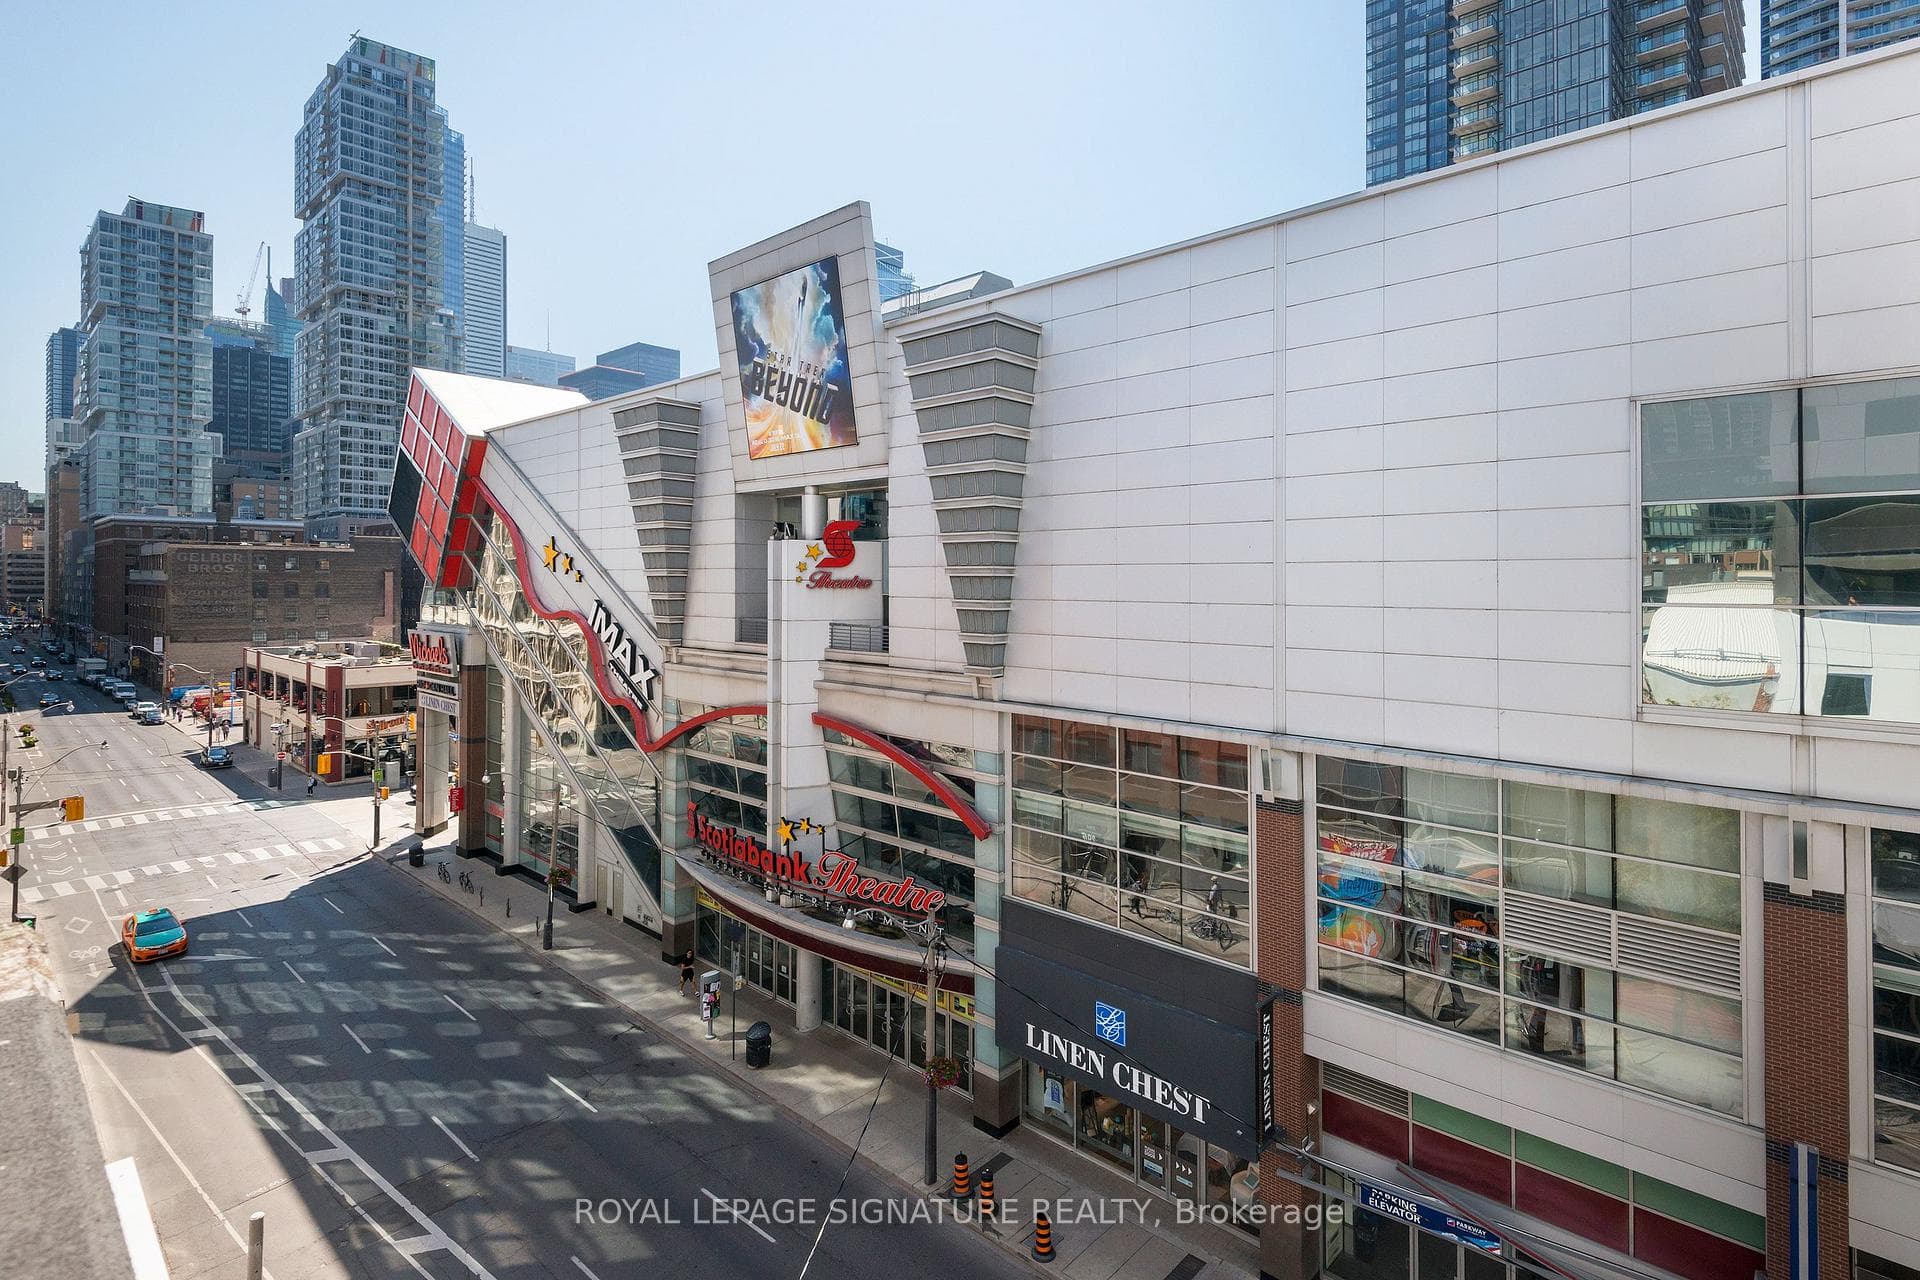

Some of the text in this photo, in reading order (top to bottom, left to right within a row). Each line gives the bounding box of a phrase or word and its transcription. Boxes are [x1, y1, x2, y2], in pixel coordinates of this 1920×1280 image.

[751, 358, 839, 425] BEYOND
[177, 552, 242, 562] GELBER
[806, 570, 873, 589] Theatre
[588, 599, 658, 700] IMAX
[698, 815, 945, 913] Scotiabank Theatre
[1025, 1022, 1211, 1124] LINEN CHEST
[1262, 1012, 1272, 1133] LINEN CHEST
[1368, 1196, 1421, 1225] ELEVATOR
[1371, 1188, 1418, 1213] PARKING
[1456, 1220, 1487, 1236] PARKWAY
